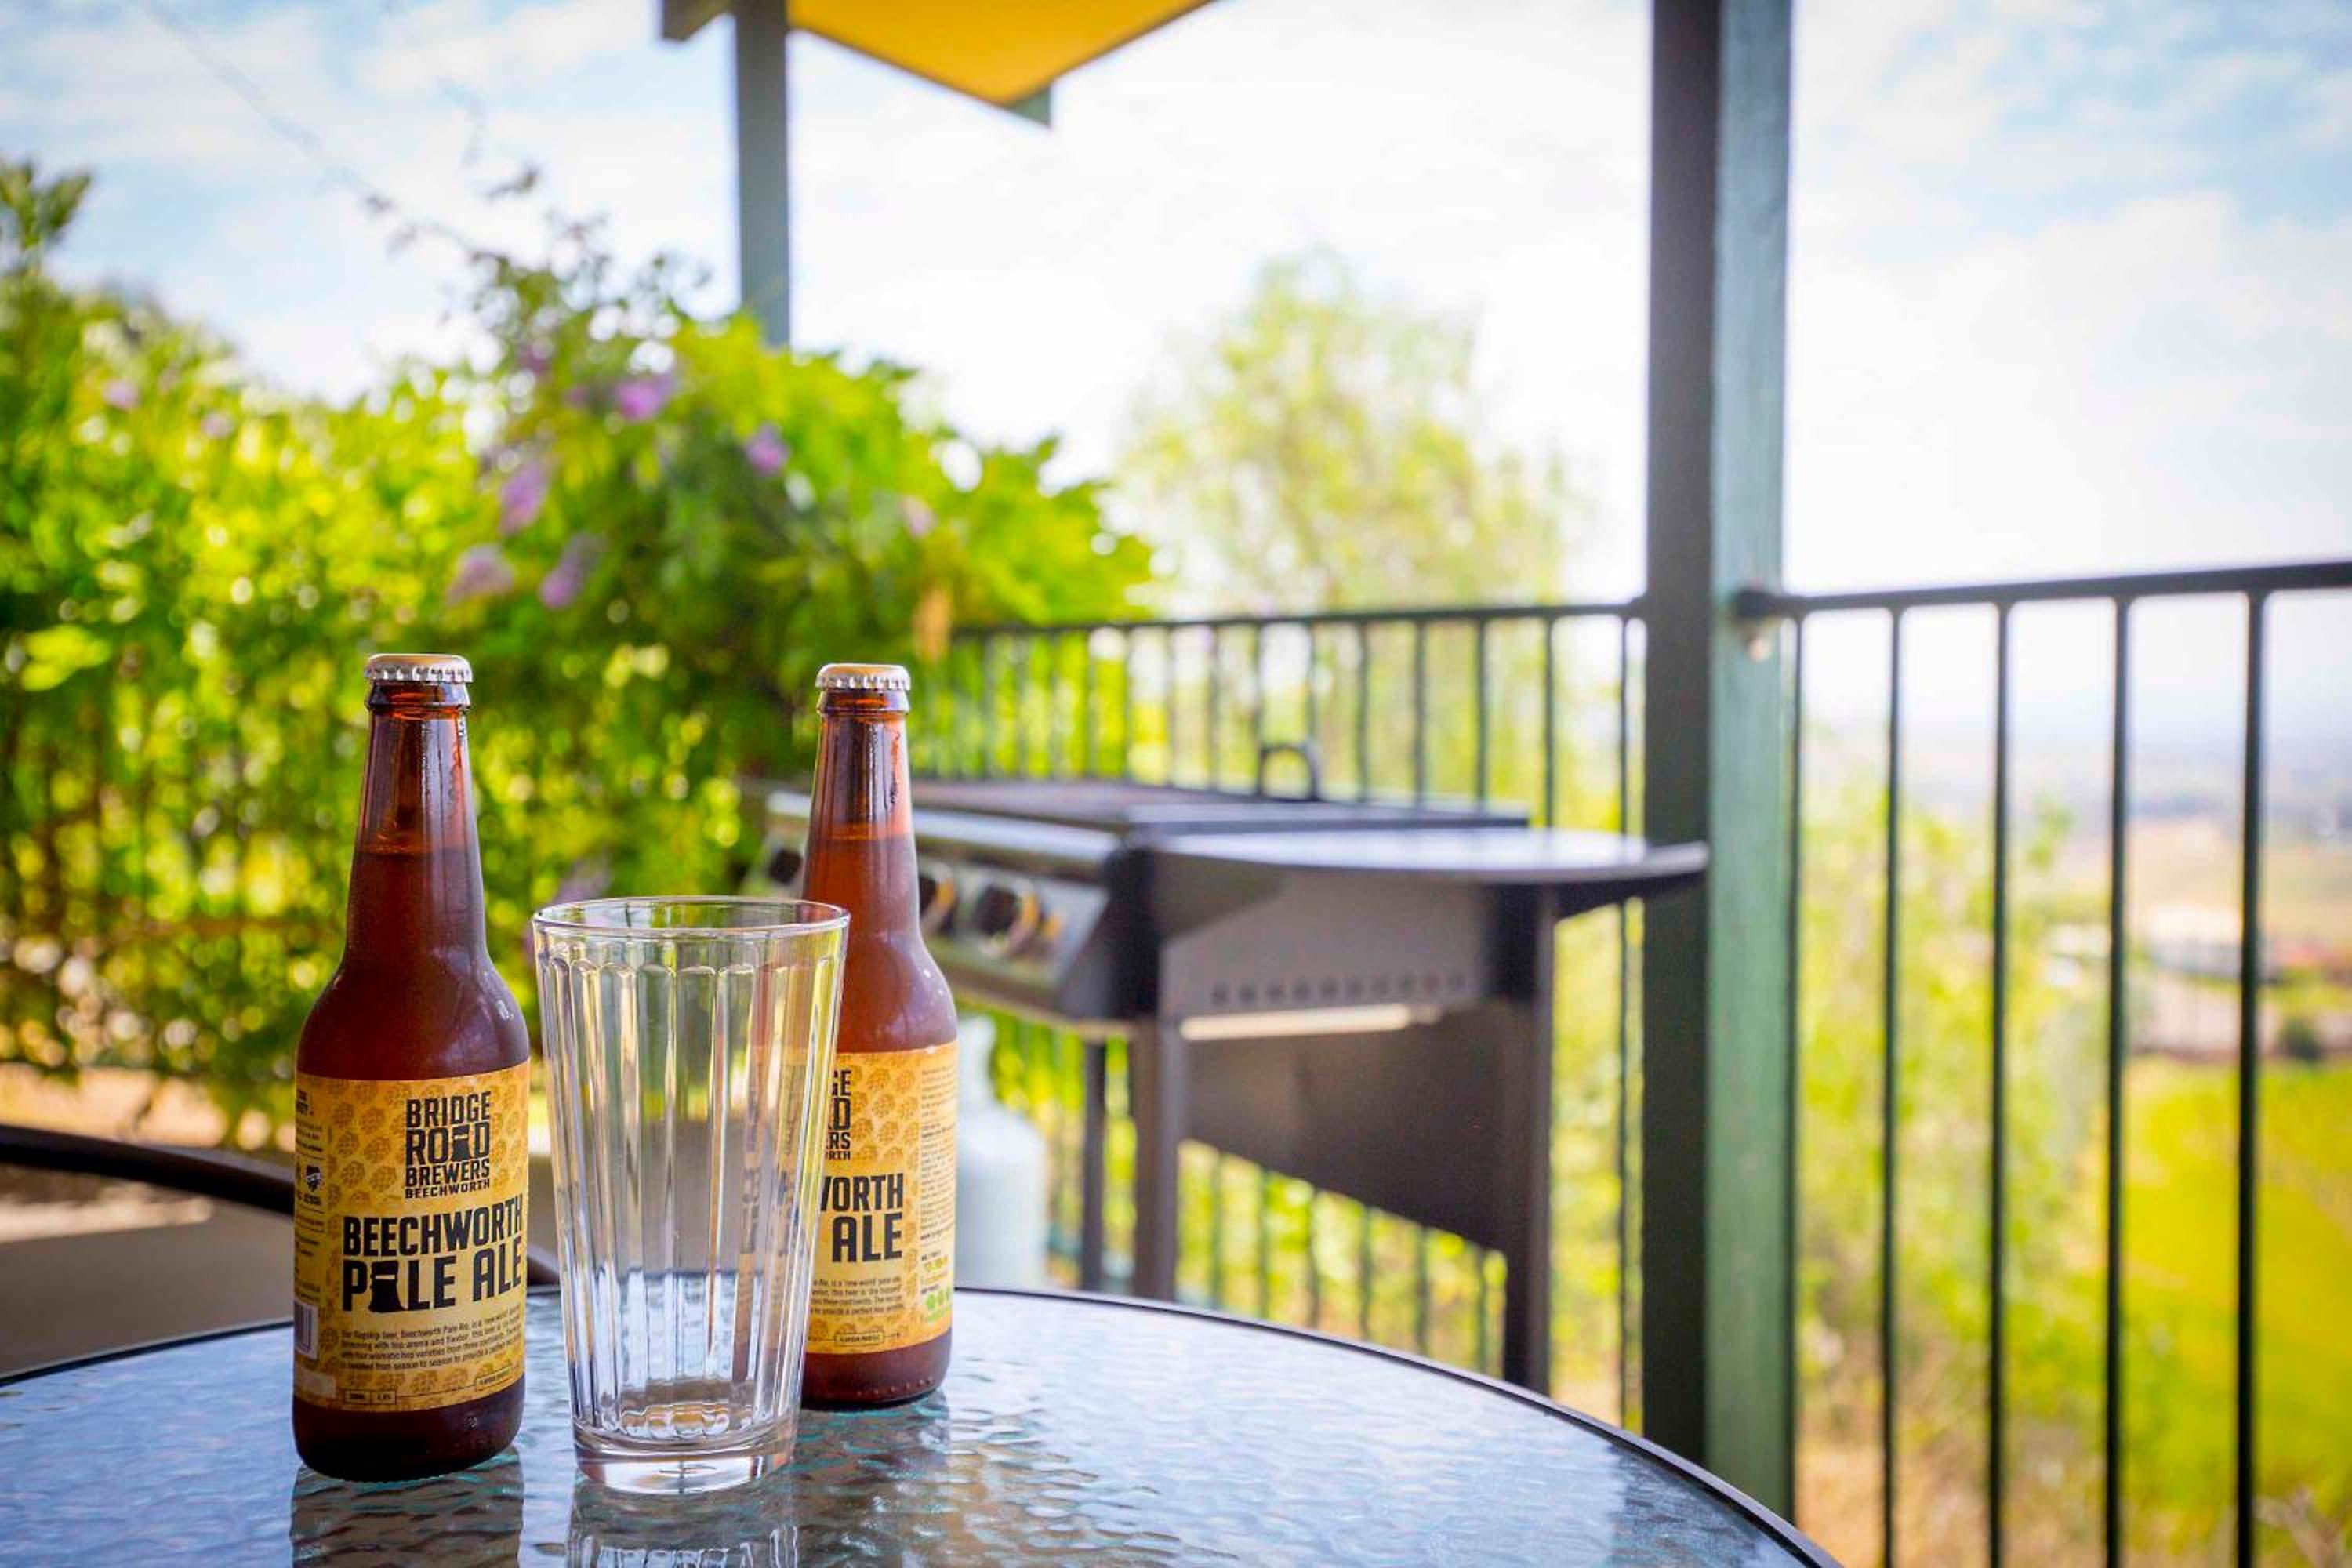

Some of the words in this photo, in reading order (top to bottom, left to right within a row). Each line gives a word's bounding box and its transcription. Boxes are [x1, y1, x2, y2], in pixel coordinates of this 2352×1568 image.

[405, 1091, 492, 1127] BRIDGE
[405, 1157, 491, 1187] BREWERS
[405, 1178, 491, 1199] BEECHWORTH
[343, 1193, 524, 1256] BEECHWORTH
[832, 1212, 903, 1263] ALE
[472, 1235, 522, 1302] ALE
